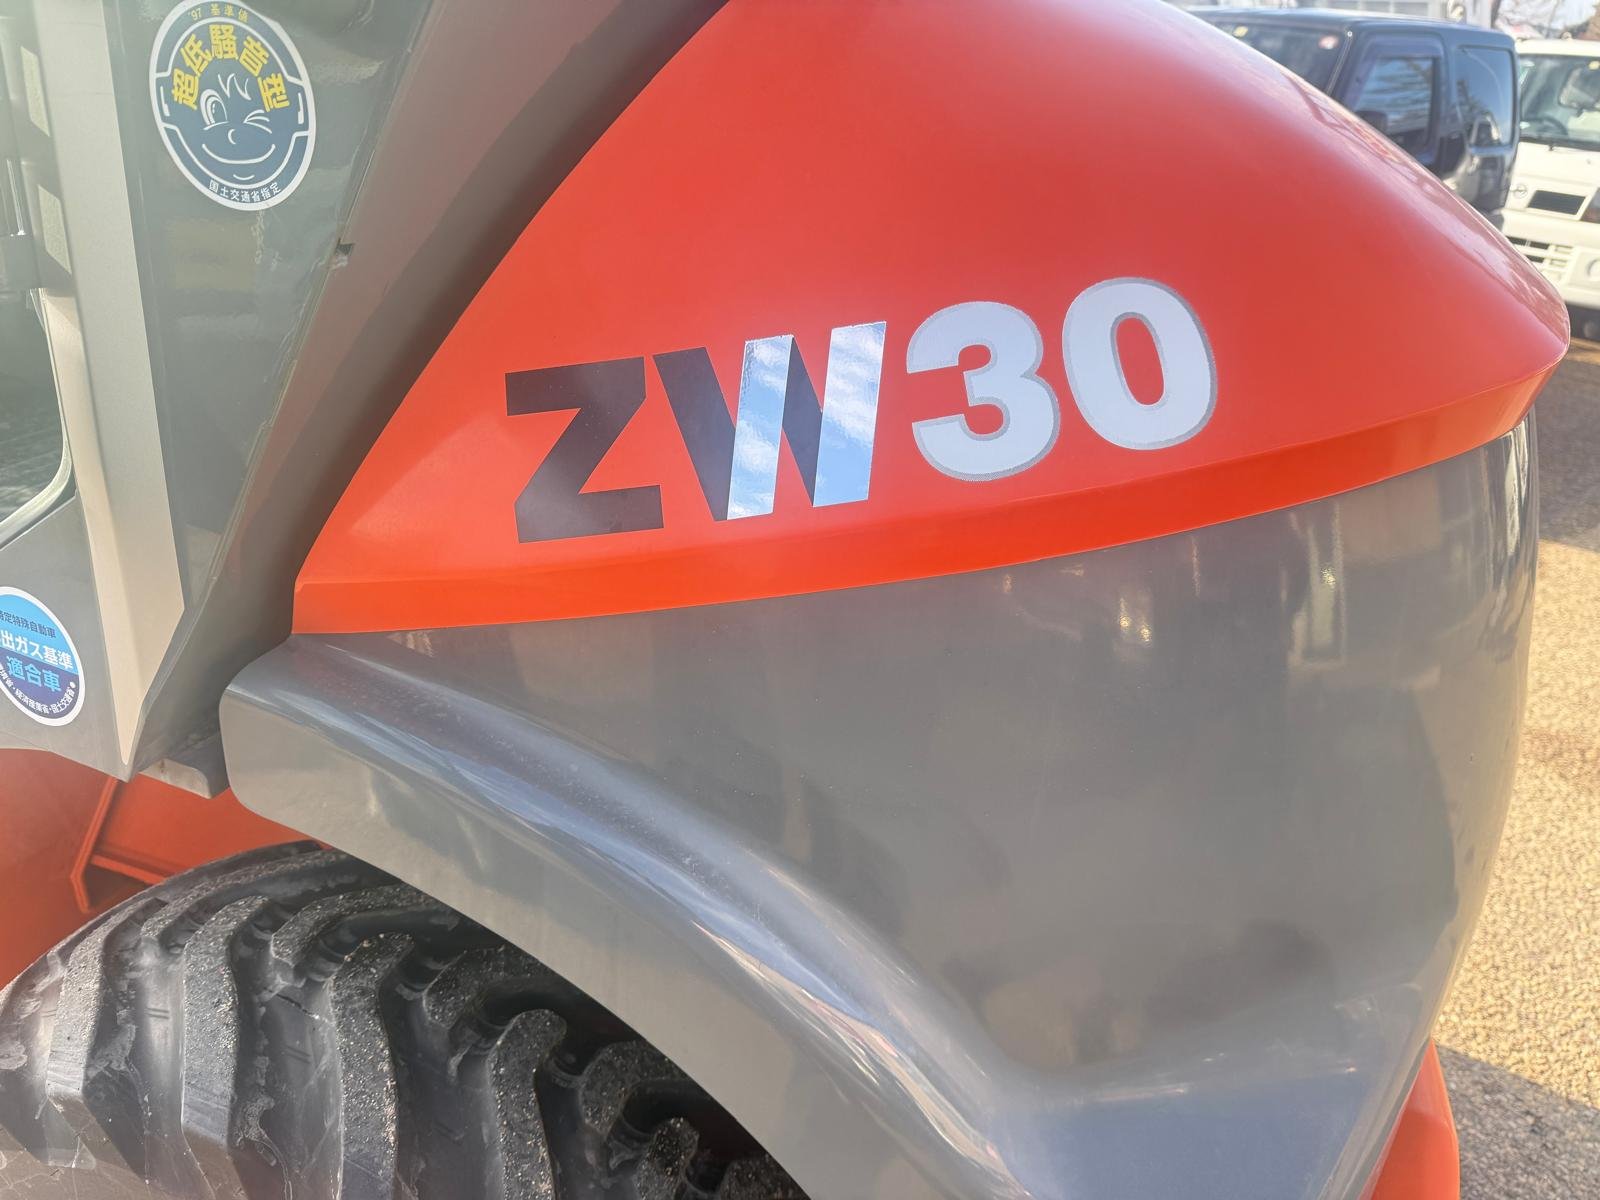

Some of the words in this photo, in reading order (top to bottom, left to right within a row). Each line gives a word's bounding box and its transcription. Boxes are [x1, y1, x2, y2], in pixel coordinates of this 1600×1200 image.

[209, 179, 281, 202] 国土交通省指定
[505, 276, 1218, 543] ZW30
[0, 629, 73, 670] 出ガス基準
[6, 656, 62, 692] 適合車
